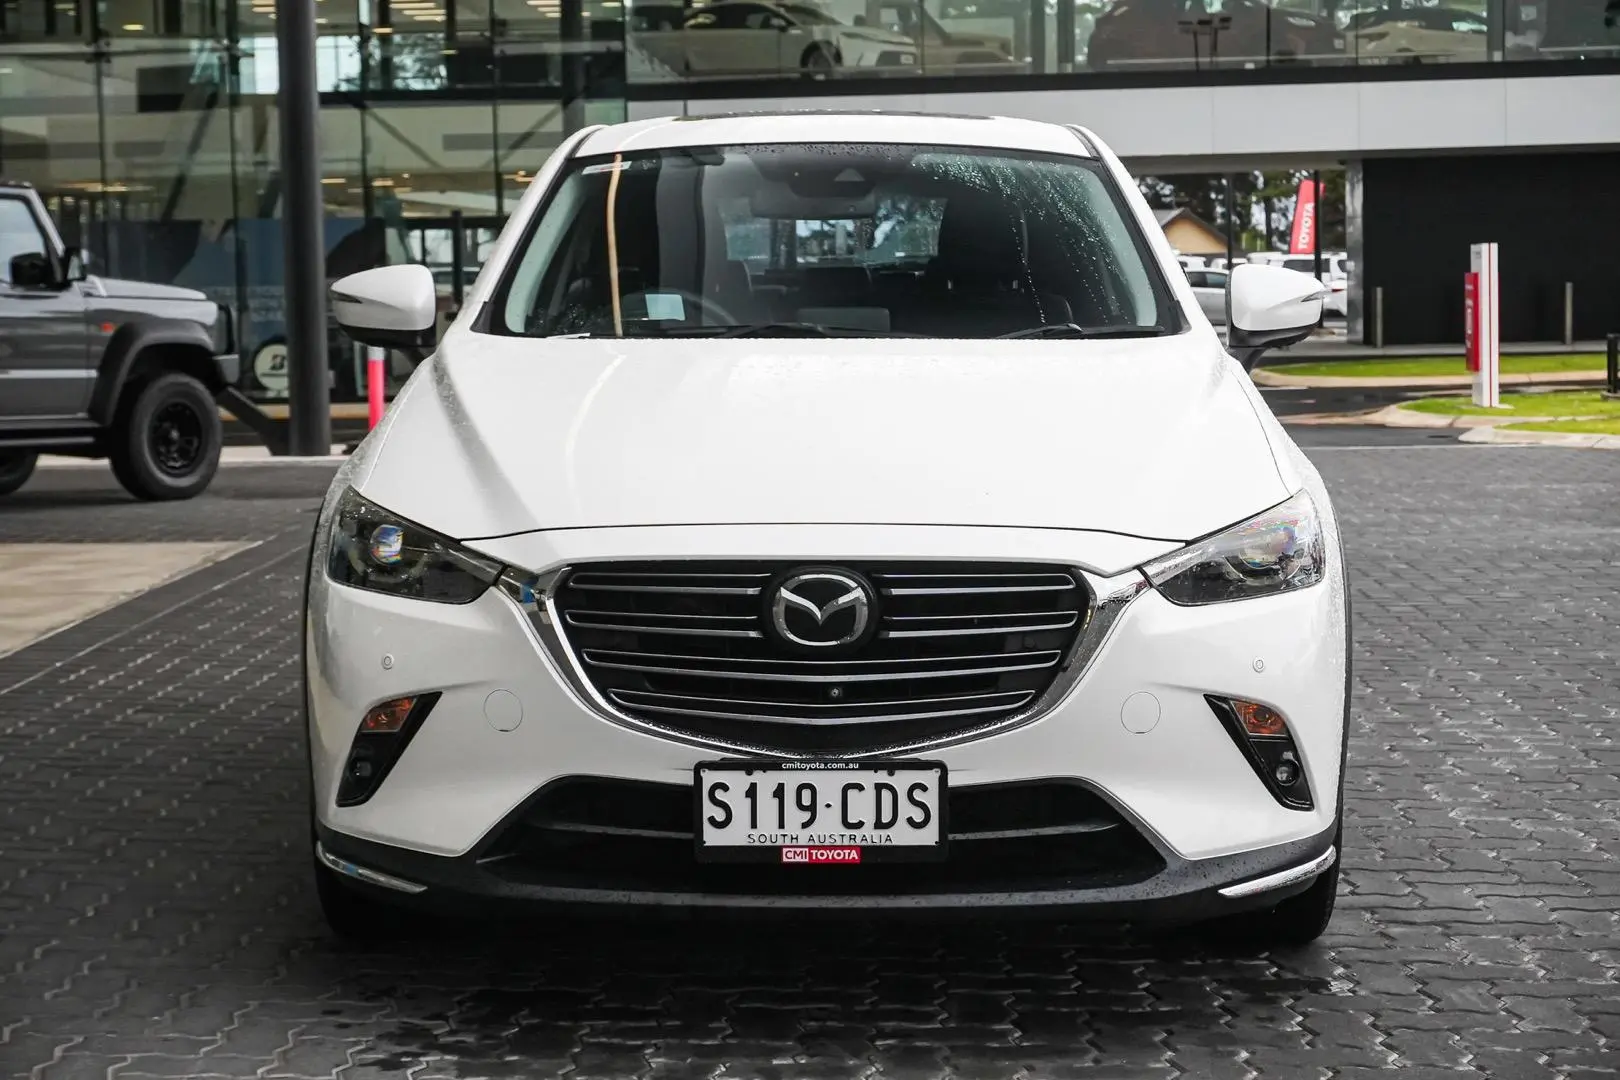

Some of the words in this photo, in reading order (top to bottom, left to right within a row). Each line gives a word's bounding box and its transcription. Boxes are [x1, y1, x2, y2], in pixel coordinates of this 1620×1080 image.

[1298, 202, 1315, 249] TOYOTA
[782, 761, 859, 770] cmitoyota.com.au
[747, 833, 799, 844] SOUTH
[807, 833, 894, 844] AUSTRALIA
[784, 849, 808, 860] CMI
[810, 849, 859, 860] TOYOTA
